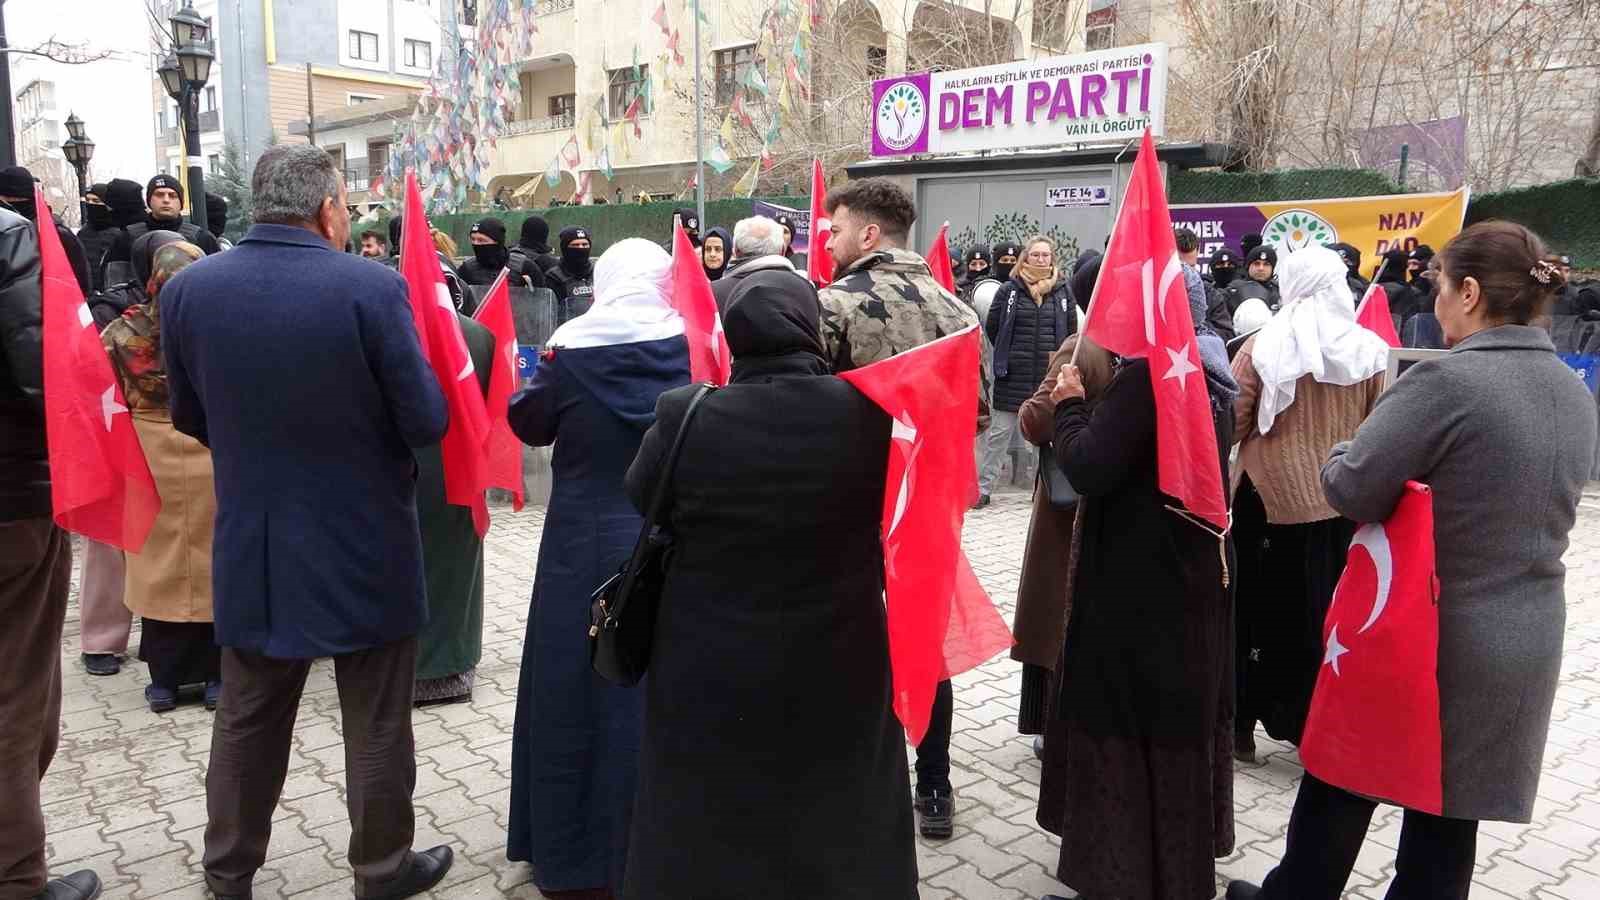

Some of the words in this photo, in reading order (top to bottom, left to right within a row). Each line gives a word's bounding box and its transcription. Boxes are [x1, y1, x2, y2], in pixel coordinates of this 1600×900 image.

[944, 75, 993, 90] HALKLARIN
[994, 69, 1028, 84] EŞİTLİK
[1030, 68, 1043, 79] VE
[1043, 60, 1098, 78] DEMOKRASİ
[1102, 54, 1142, 70] PARTİSİ
[938, 84, 1014, 131] DEM
[1025, 53, 1152, 122] PARTİ
[1066, 123, 1088, 136] VAN
[1090, 122, 1101, 134] İL
[1080, 187, 1092, 198] 14
[1378, 211, 1424, 231] NAN
